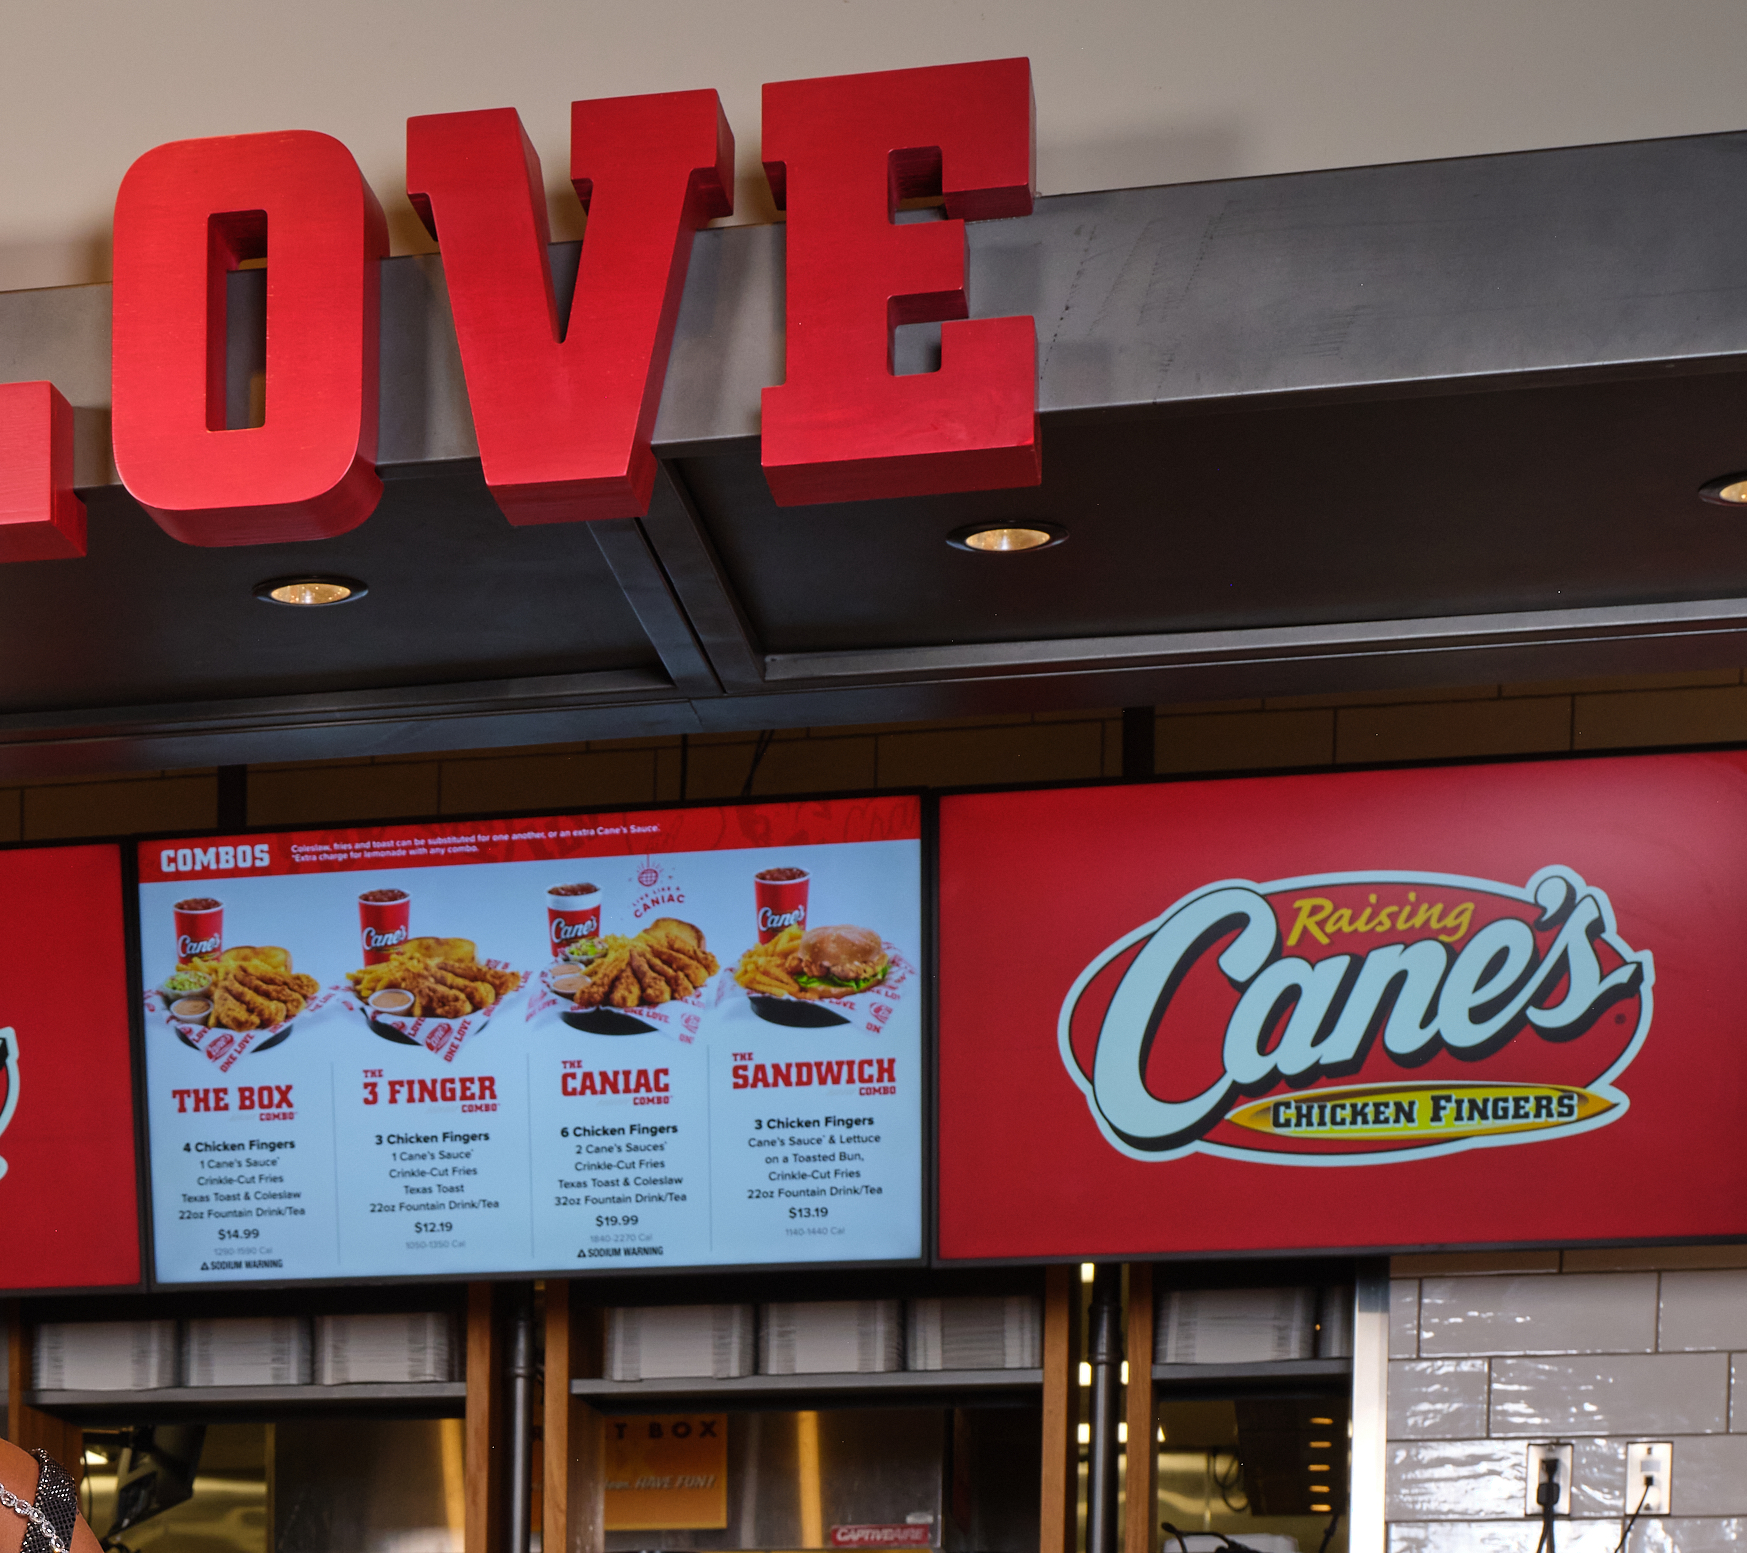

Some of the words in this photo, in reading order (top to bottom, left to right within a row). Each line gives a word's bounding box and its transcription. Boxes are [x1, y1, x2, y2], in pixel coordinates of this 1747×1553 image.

[161, 844, 270, 872] COMBOS
[1287, 892, 1475, 945] Raising
[1093, 876, 1644, 1152] Cane's
[732, 1053, 753, 1061] THE
[562, 1060, 582, 1068] THE
[363, 1069, 383, 1078] THE
[732, 1058, 895, 1089] SANDWICH
[562, 1068, 669, 1096] CANIAC
[363, 1082, 378, 1105] 3
[388, 1076, 497, 1104] FINGER
[859, 1086, 896, 1096] COMBO
[172, 1088, 229, 1113] THE
[238, 1085, 293, 1110] BOX
[633, 1096, 669, 1105] COMBO
[462, 1104, 497, 1113] COMBO
[1272, 1095, 1416, 1129] CHICKEN
[1430, 1091, 1576, 1123] FINGERS
[260, 1112, 294, 1121] COMBO
[755, 1120, 762, 1130] 3
[767, 1118, 820, 1129] Chicken
[825, 1116, 874, 1128] Fingers
[561, 1127, 569, 1137] 6
[573, 1126, 625, 1137] Chicken
[630, 1124, 678, 1136] Fingers
[375, 1135, 382, 1145] 3
[387, 1133, 438, 1144] Chicken
[442, 1132, 489, 1144] Fingers
[748, 1137, 785, 1147] Cane's
[829, 1135, 835, 1144] &
[840, 1134, 881, 1143] Lettuce
[183, 1143, 191, 1152] 4
[195, 1141, 245, 1152] Chicken
[249, 1140, 295, 1151] Fingers
[400, 1151, 435, 1161] Cane's
[765, 1156, 779, 1164] on
[792, 1153, 835, 1163] Toasted
[839, 1152, 864, 1161] Bun,
[389, 1168, 448, 1178] Crinkle-Cut
[452, 1167, 477, 1176] Fries
[404, 1186, 432, 1194] Texas
[437, 1185, 464, 1193] Toast
[370, 1203, 395, 1212] 22oz
[399, 1201, 445, 1212] Fountain
[449, 1199, 499, 1210] Drink/Tea
[789, 1207, 828, 1218] $13.19
[596, 1215, 638, 1227] $19.99
[415, 1222, 452, 1233] $12.19
[218, 1229, 259, 1239] $14.99
[649, 1420, 718, 1439] BOX
